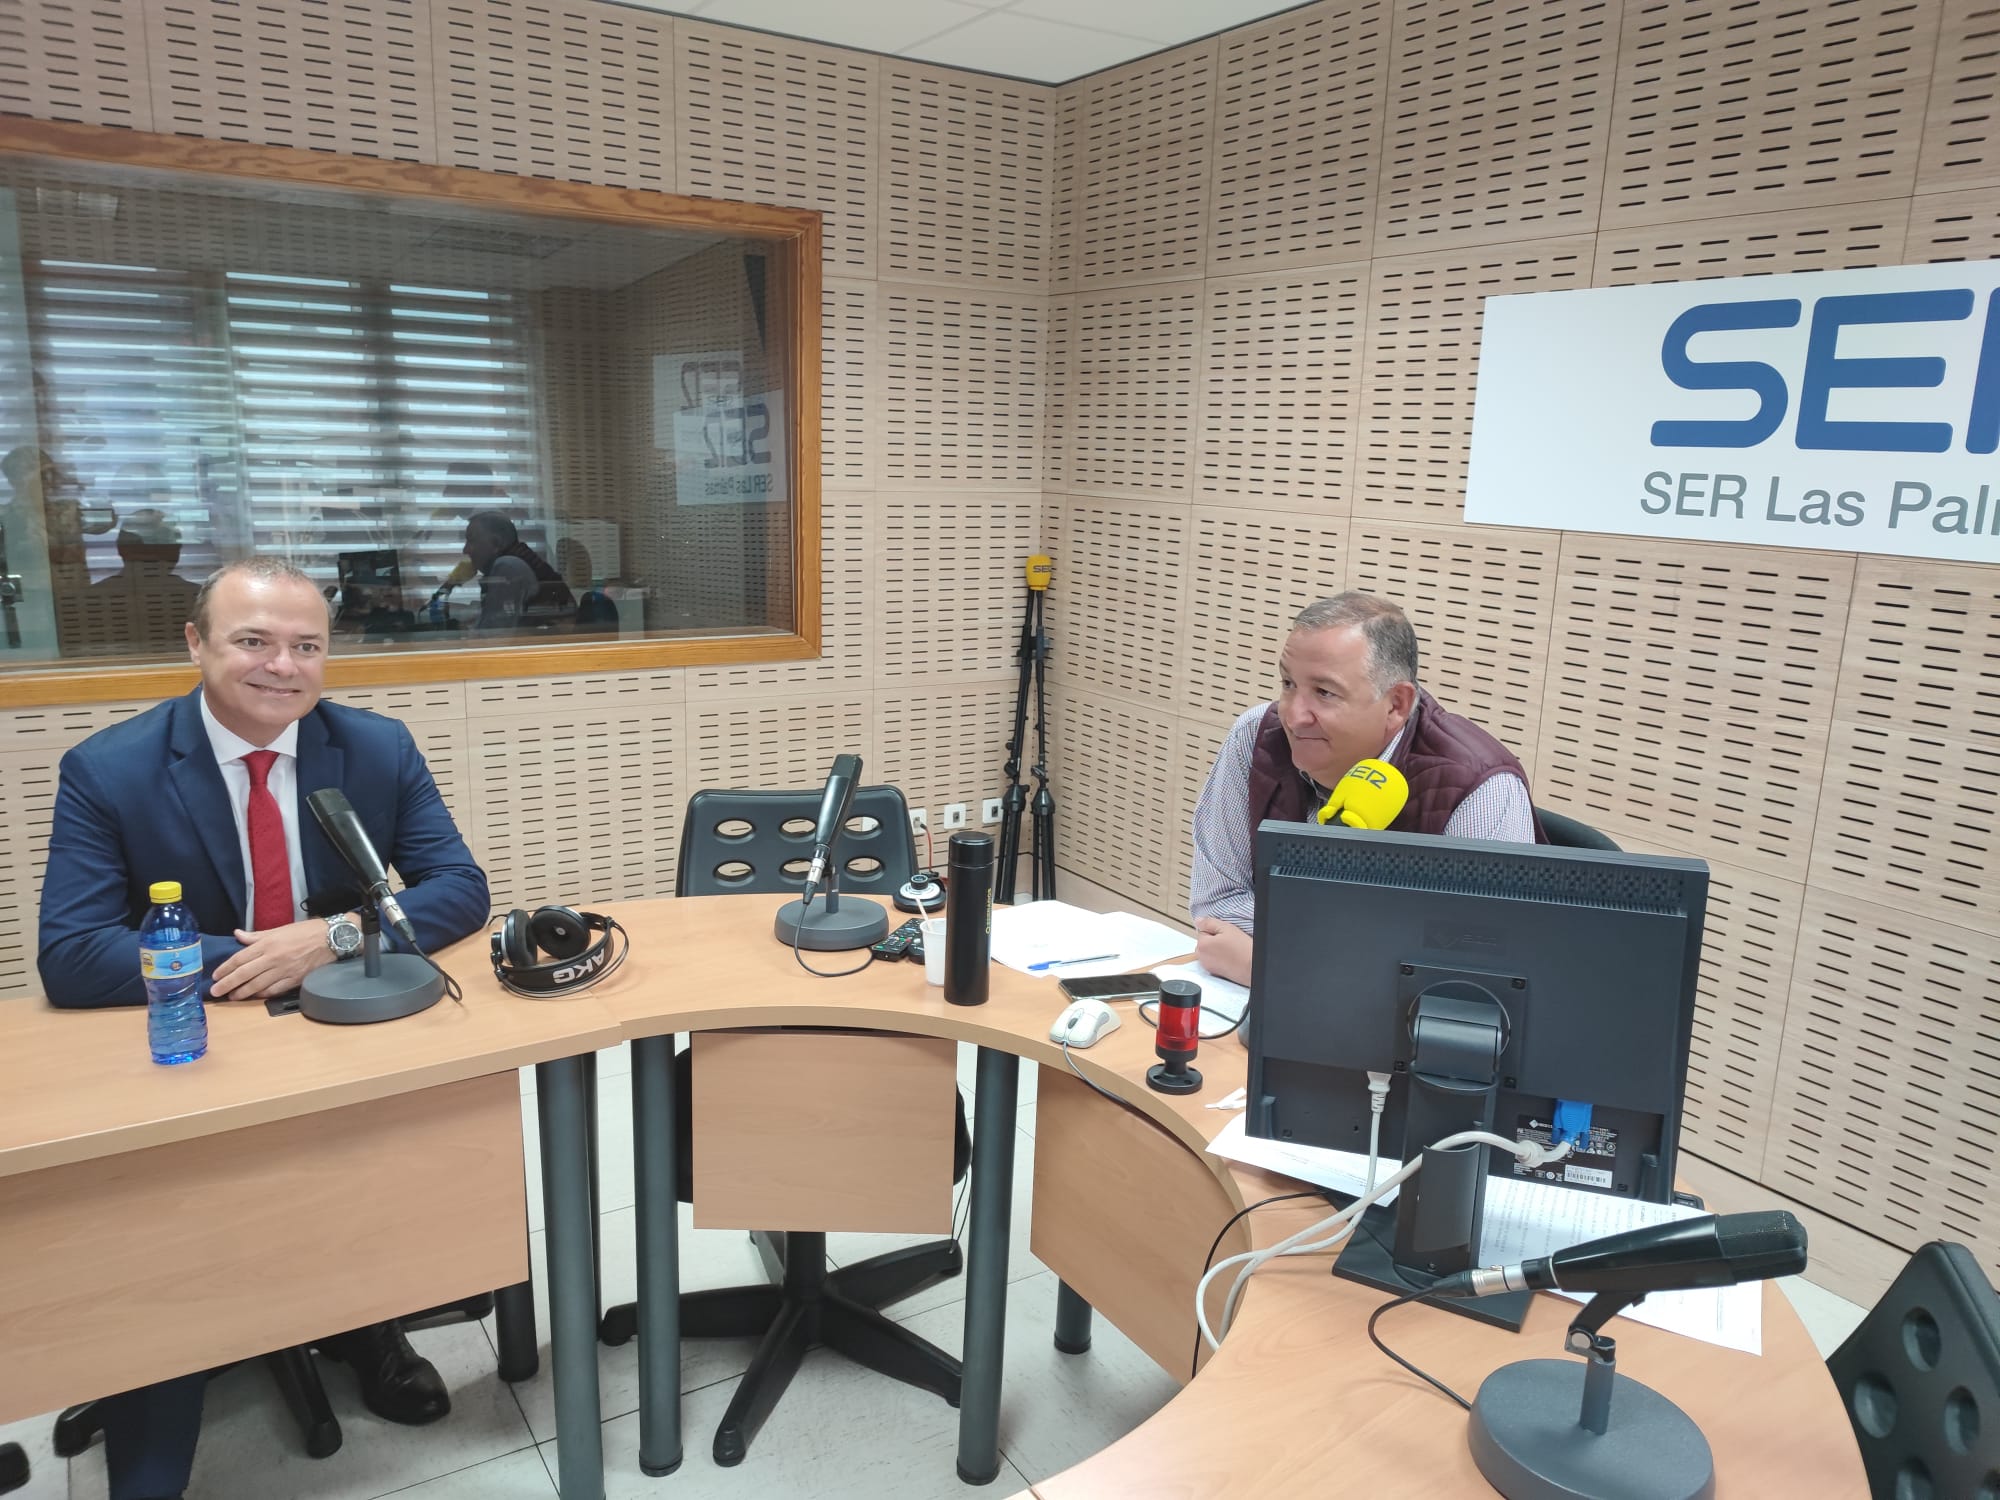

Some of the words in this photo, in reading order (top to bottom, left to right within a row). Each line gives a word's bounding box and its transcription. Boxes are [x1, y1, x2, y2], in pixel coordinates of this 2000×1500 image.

[1650, 286, 2000, 455] SE
[1640, 471, 1748, 519] SER
[1766, 476, 1866, 527] Las
[1888, 480, 2000, 537] Pal
[552, 948, 605, 984] AKG
